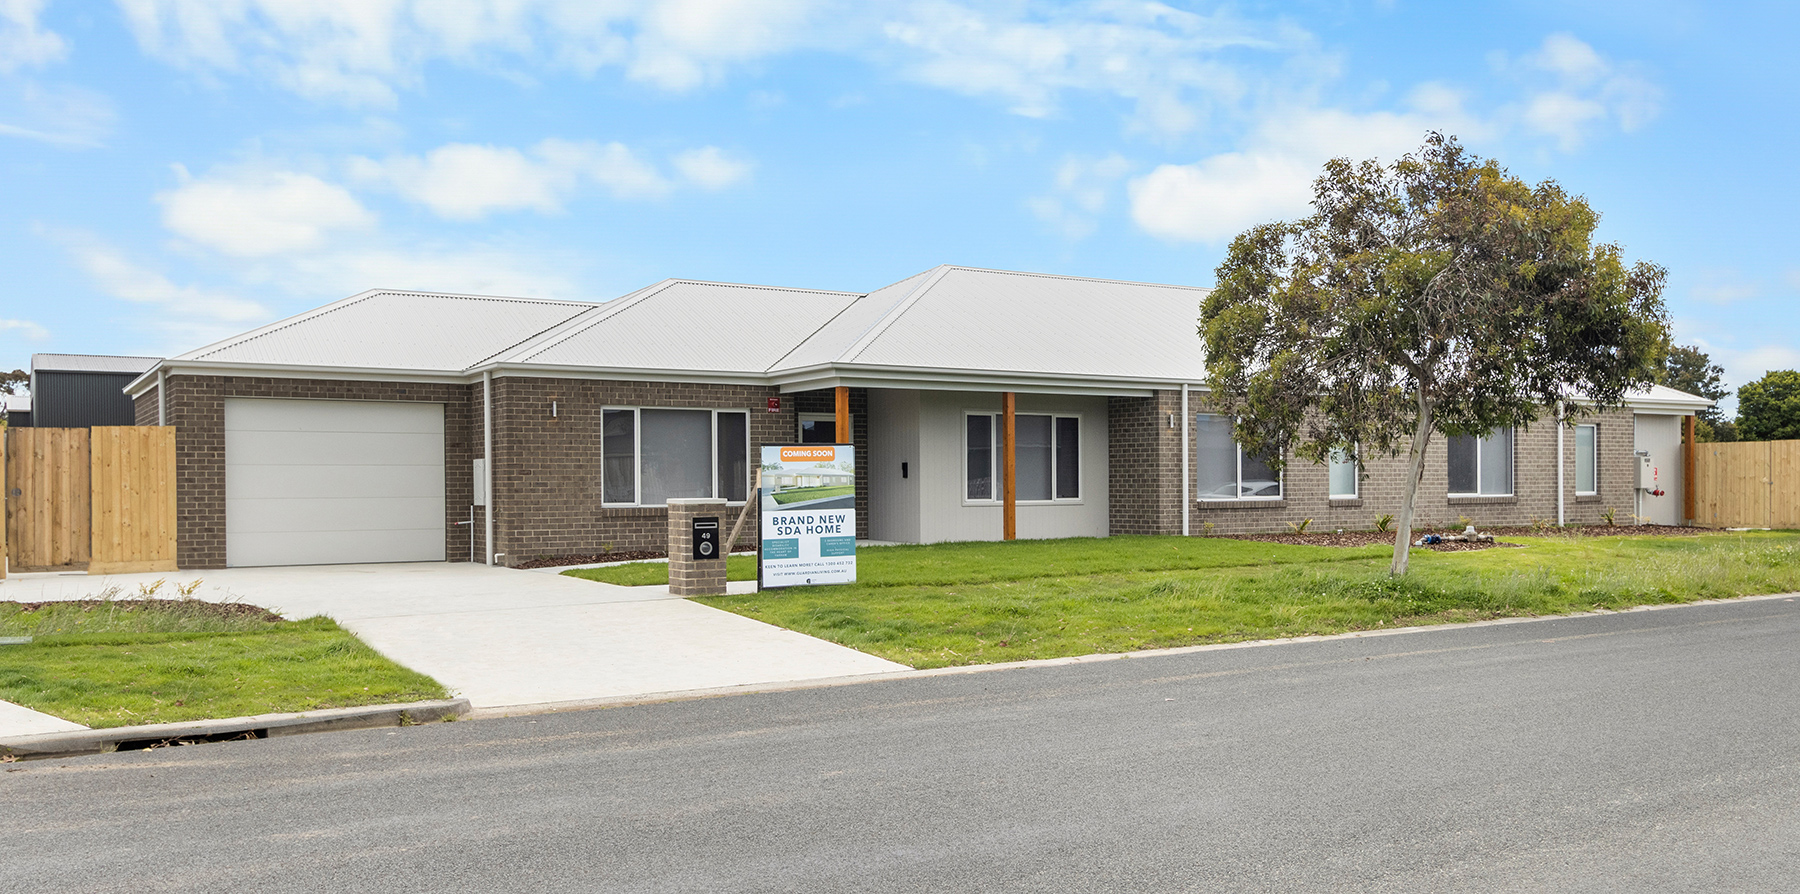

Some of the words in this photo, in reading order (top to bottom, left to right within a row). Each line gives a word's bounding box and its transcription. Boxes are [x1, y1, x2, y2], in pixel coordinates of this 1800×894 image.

[772, 516, 814, 525] BRAND
[820, 515, 845, 524] NEW
[777, 526, 801, 535] SDA
[807, 525, 841, 534] HOME
